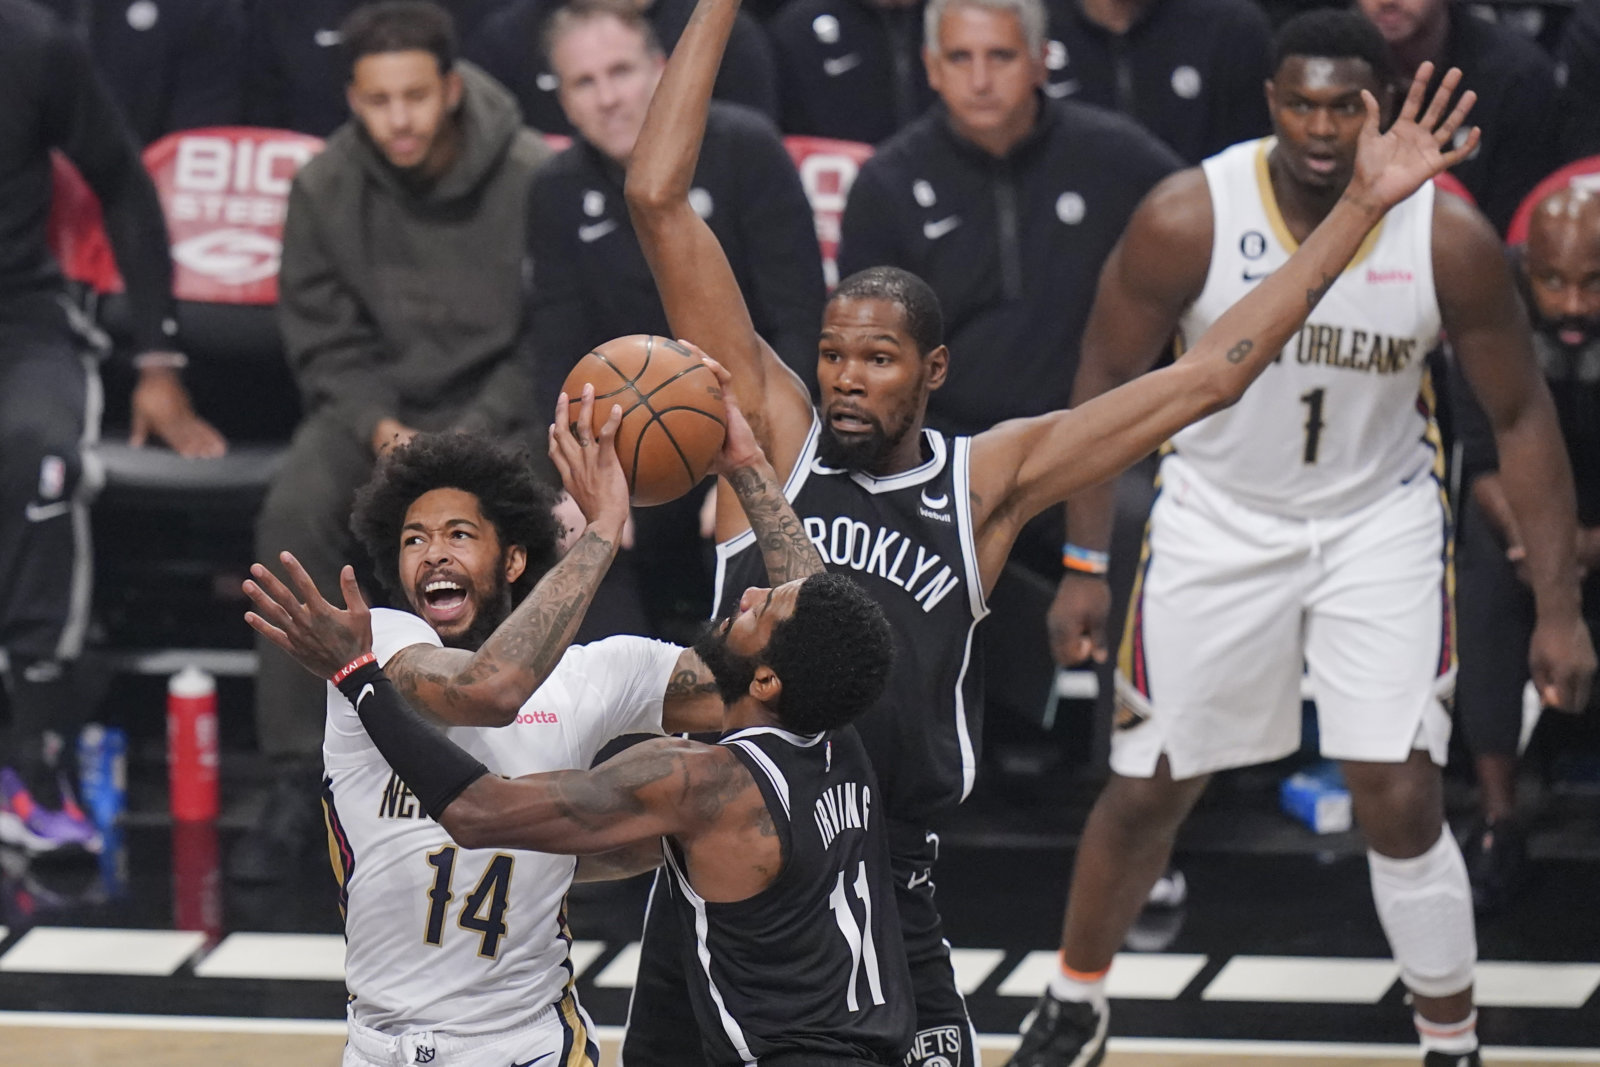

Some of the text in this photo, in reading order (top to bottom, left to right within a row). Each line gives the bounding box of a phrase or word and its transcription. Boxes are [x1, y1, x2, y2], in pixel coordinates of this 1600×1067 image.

[1297, 323, 1416, 373] ORLEANS
[1300, 386, 1326, 465] 1
[803, 516, 959, 613] ROOKLYN
[379, 769, 427, 818] NE
[813, 782, 870, 852] IRVING
[423, 843, 516, 961] 14
[829, 860, 886, 1012] 11
[906, 1028, 959, 1065] NETS
